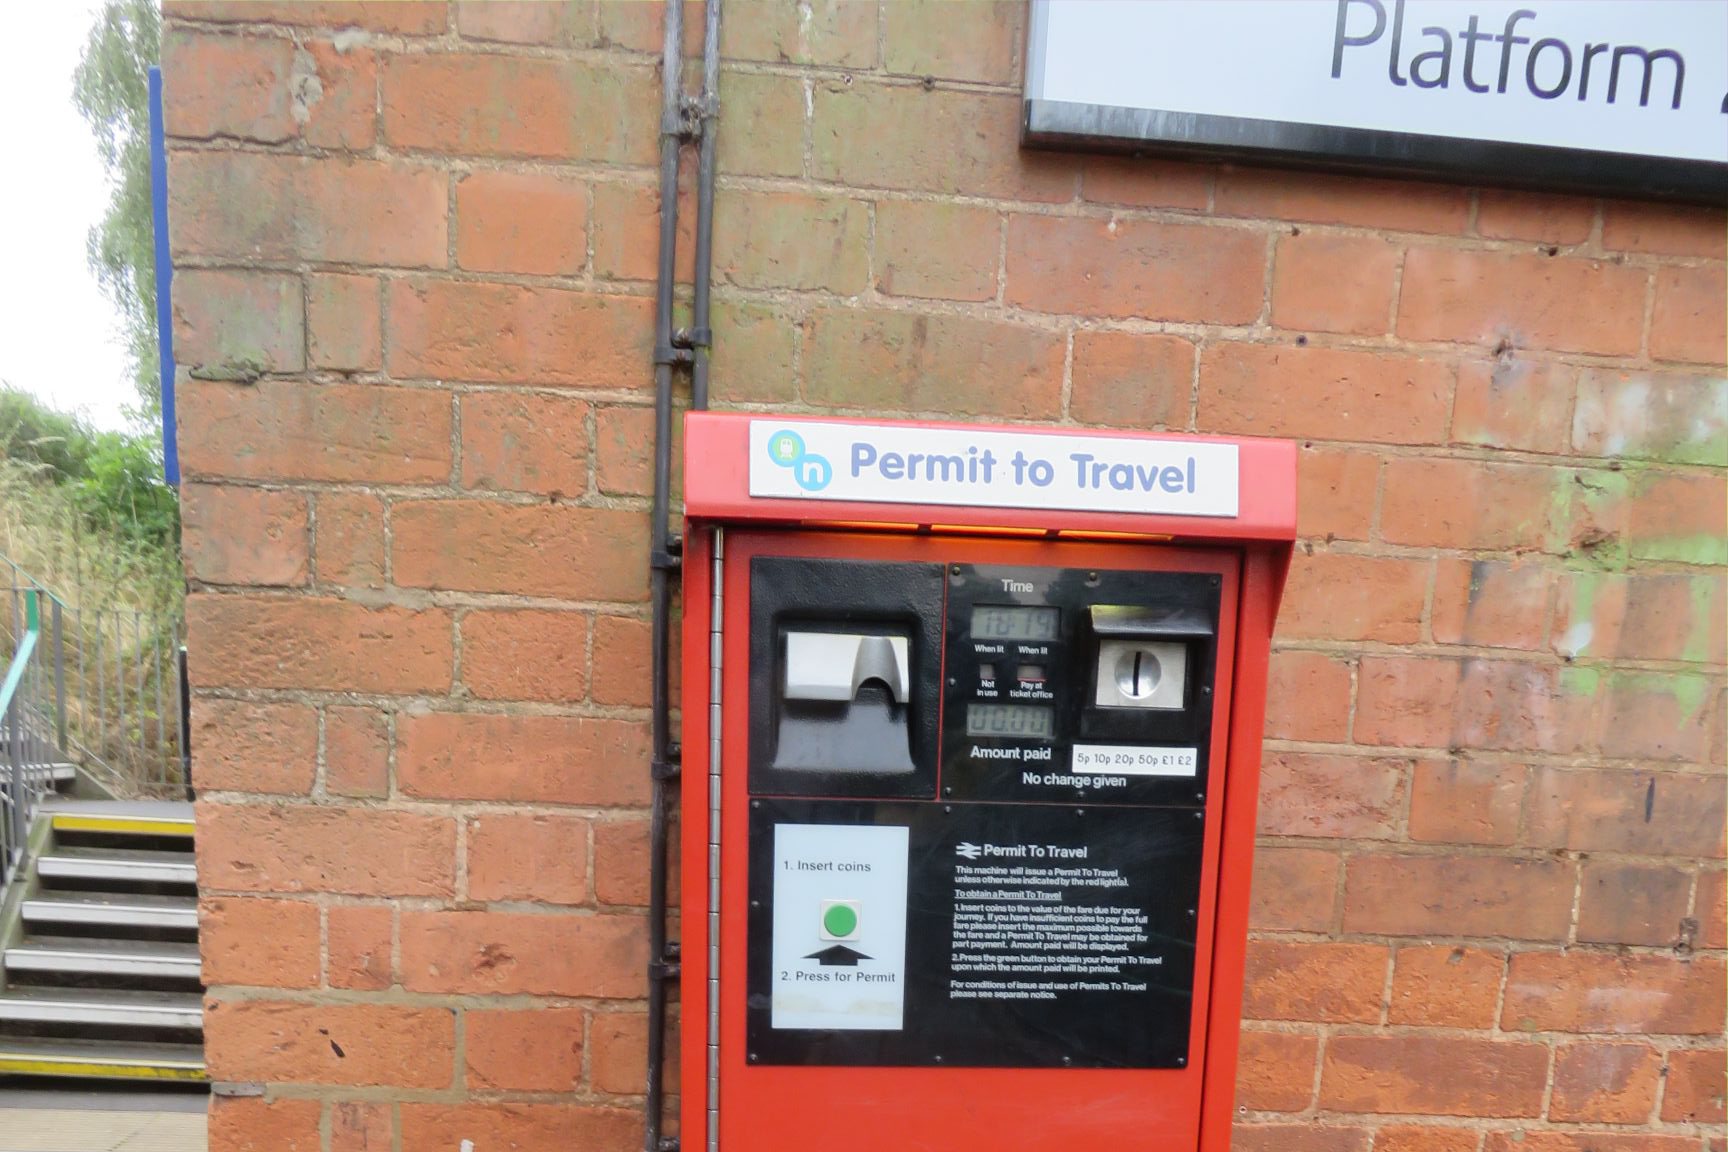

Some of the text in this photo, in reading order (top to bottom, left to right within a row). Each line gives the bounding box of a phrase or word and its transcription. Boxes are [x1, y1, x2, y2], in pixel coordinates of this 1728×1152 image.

[1331, 0, 1686, 109] Platform
[850, 443, 1195, 494] Permit to Travel
[1002, 579, 1033, 592] Time
[975, 645, 996, 653] When
[1019, 646, 1039, 654] When
[982, 680, 994, 688] Not
[1021, 682, 1034, 690] Pay
[1010, 690, 1053, 698] ticket office
[970, 746, 1051, 761] Amount paid
[1077, 753, 1191, 766] 5p 10p 20p 50p £1 £2
[1023, 772, 1126, 788] No change given
[984, 844, 1087, 858] Permit To Travel
[798, 860, 832, 871] Insert
[838, 861, 871, 872] coins
[956, 866, 973, 874] This
[974, 866, 1008, 875] machine
[1010, 867, 1023, 875] will
[1055, 868, 1081, 876] Permit
[1082, 868, 1092, 876] To
[1093, 869, 1118, 877] Travel
[982, 876, 1021, 884] otherwise
[1023, 877, 1059, 885] indicated
[1061, 878, 1070, 886] by
[955, 889, 965, 898] To
[966, 890, 991, 898] obtain
[999, 890, 1024, 898] Permit
[1026, 891, 1036, 899] To
[1037, 891, 1062, 899] Travel
[1031, 905, 1052, 913] value
[1123, 908, 1140, 916] your
[971, 922, 997, 930] please
[1035, 932, 1044, 940] To
[971, 941, 1008, 949] payment.
[1011, 941, 1042, 949] Amount
[1043, 942, 1061, 950] paid
[997, 955, 1020, 963] green
[1128, 956, 1137, 964] To
[973, 963, 996, 971] which
[1043, 964, 1061, 973] paid
[781, 971, 895, 982] 2. Press for Permit
[951, 980, 964, 988] For
[965, 981, 1006, 989] conditions
[1007, 981, 1015, 989] of
[1080, 982, 1109, 990] Permits
[1110, 982, 1121, 990] To
[1122, 983, 1146, 991] Travel
